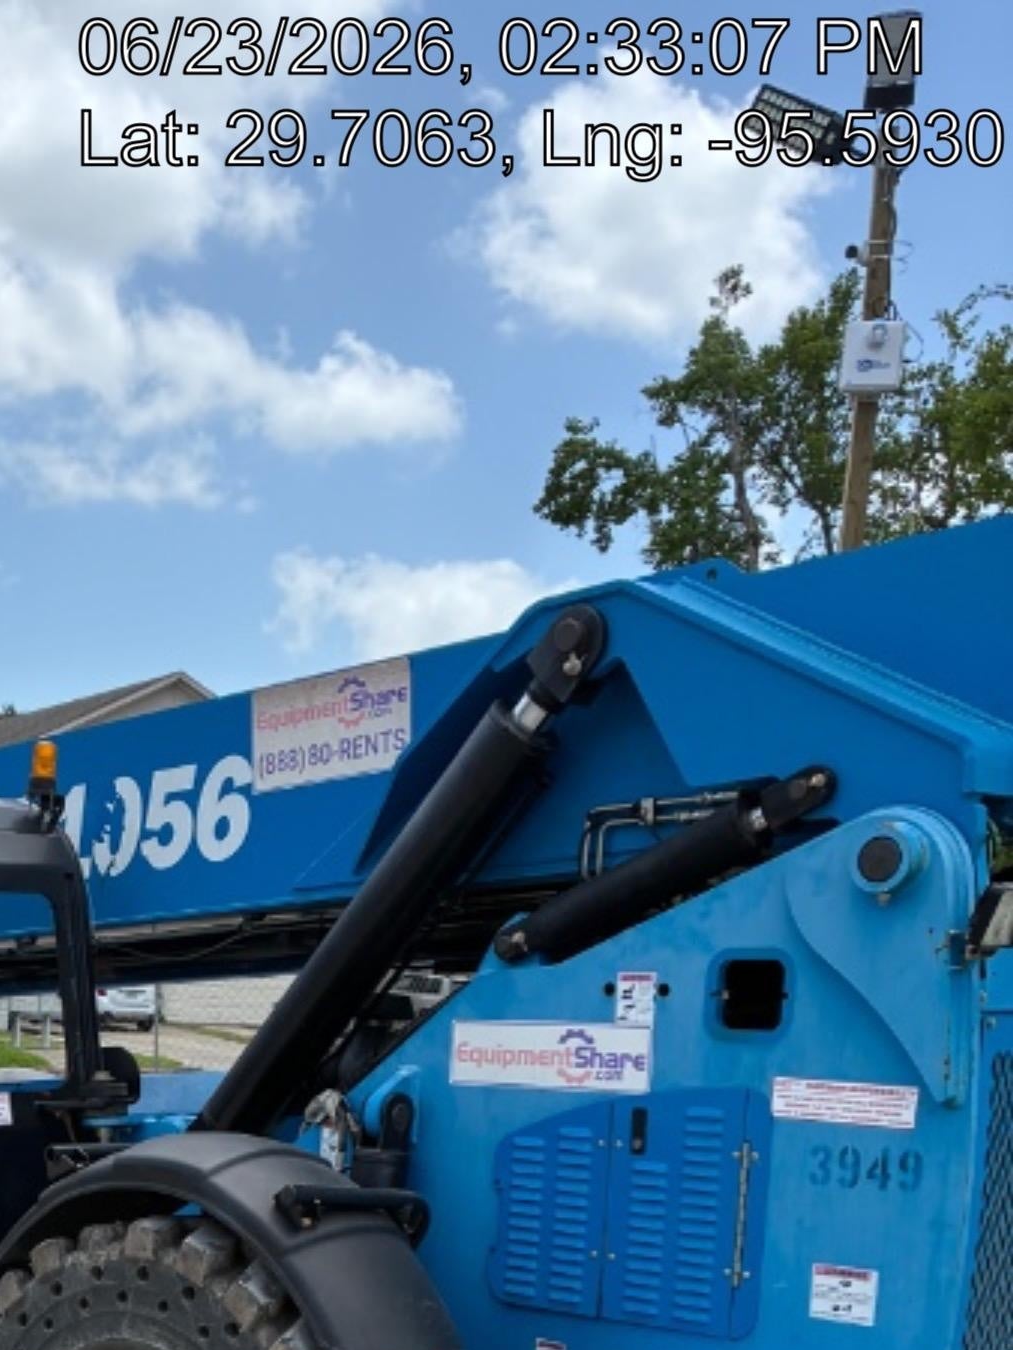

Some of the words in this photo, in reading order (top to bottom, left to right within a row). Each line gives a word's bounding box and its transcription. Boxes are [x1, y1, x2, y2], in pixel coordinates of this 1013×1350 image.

[256, 686, 408, 733] EquipmentShare
[456, 1042, 648, 1072] EquipmentShare
[808, 1144, 924, 1192] 3949
